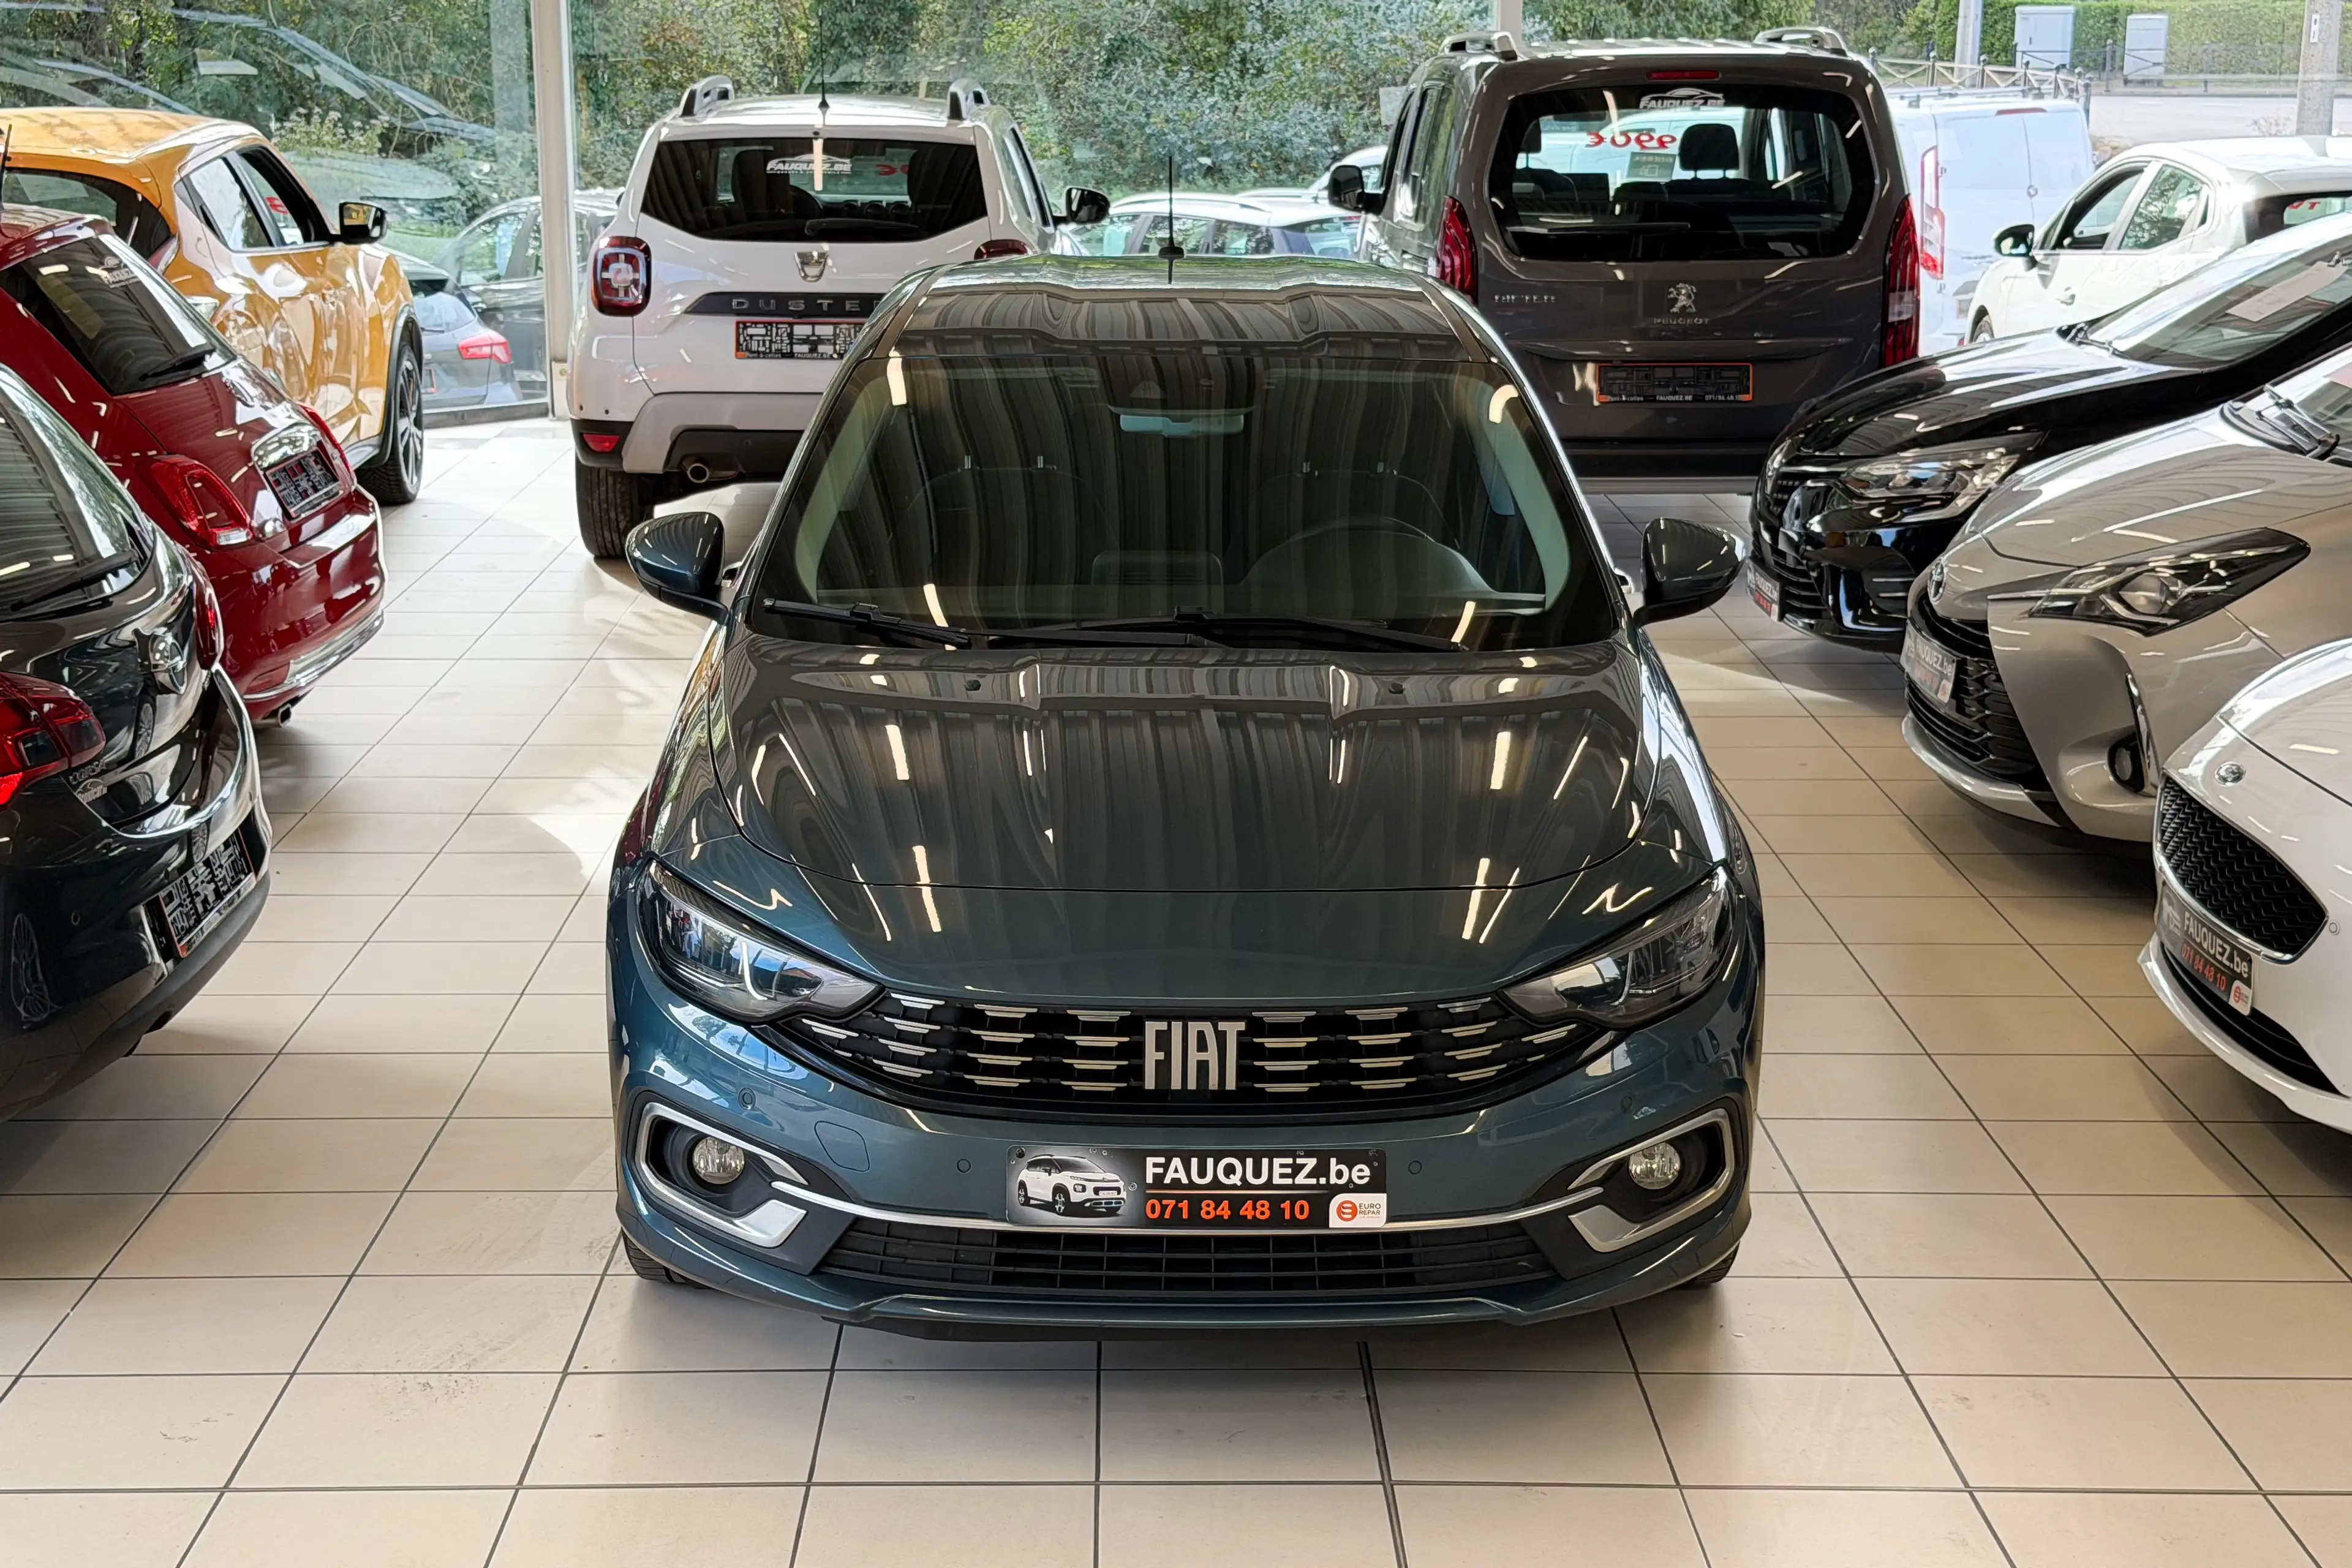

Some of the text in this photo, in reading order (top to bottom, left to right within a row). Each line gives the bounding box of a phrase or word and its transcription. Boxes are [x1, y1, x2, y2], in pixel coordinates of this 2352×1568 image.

[766, 162, 852, 171] FAUQUZ.BE
[2184, 911, 2249, 979] FAUQUEZ.be
[2216, 973, 2227, 991] 10
[1144, 1020, 1246, 1091] FIAT
[1145, 1156, 1371, 1186] FAUQUEZ.be
[1145, 1199, 1310, 1220] 071 84 48 10
